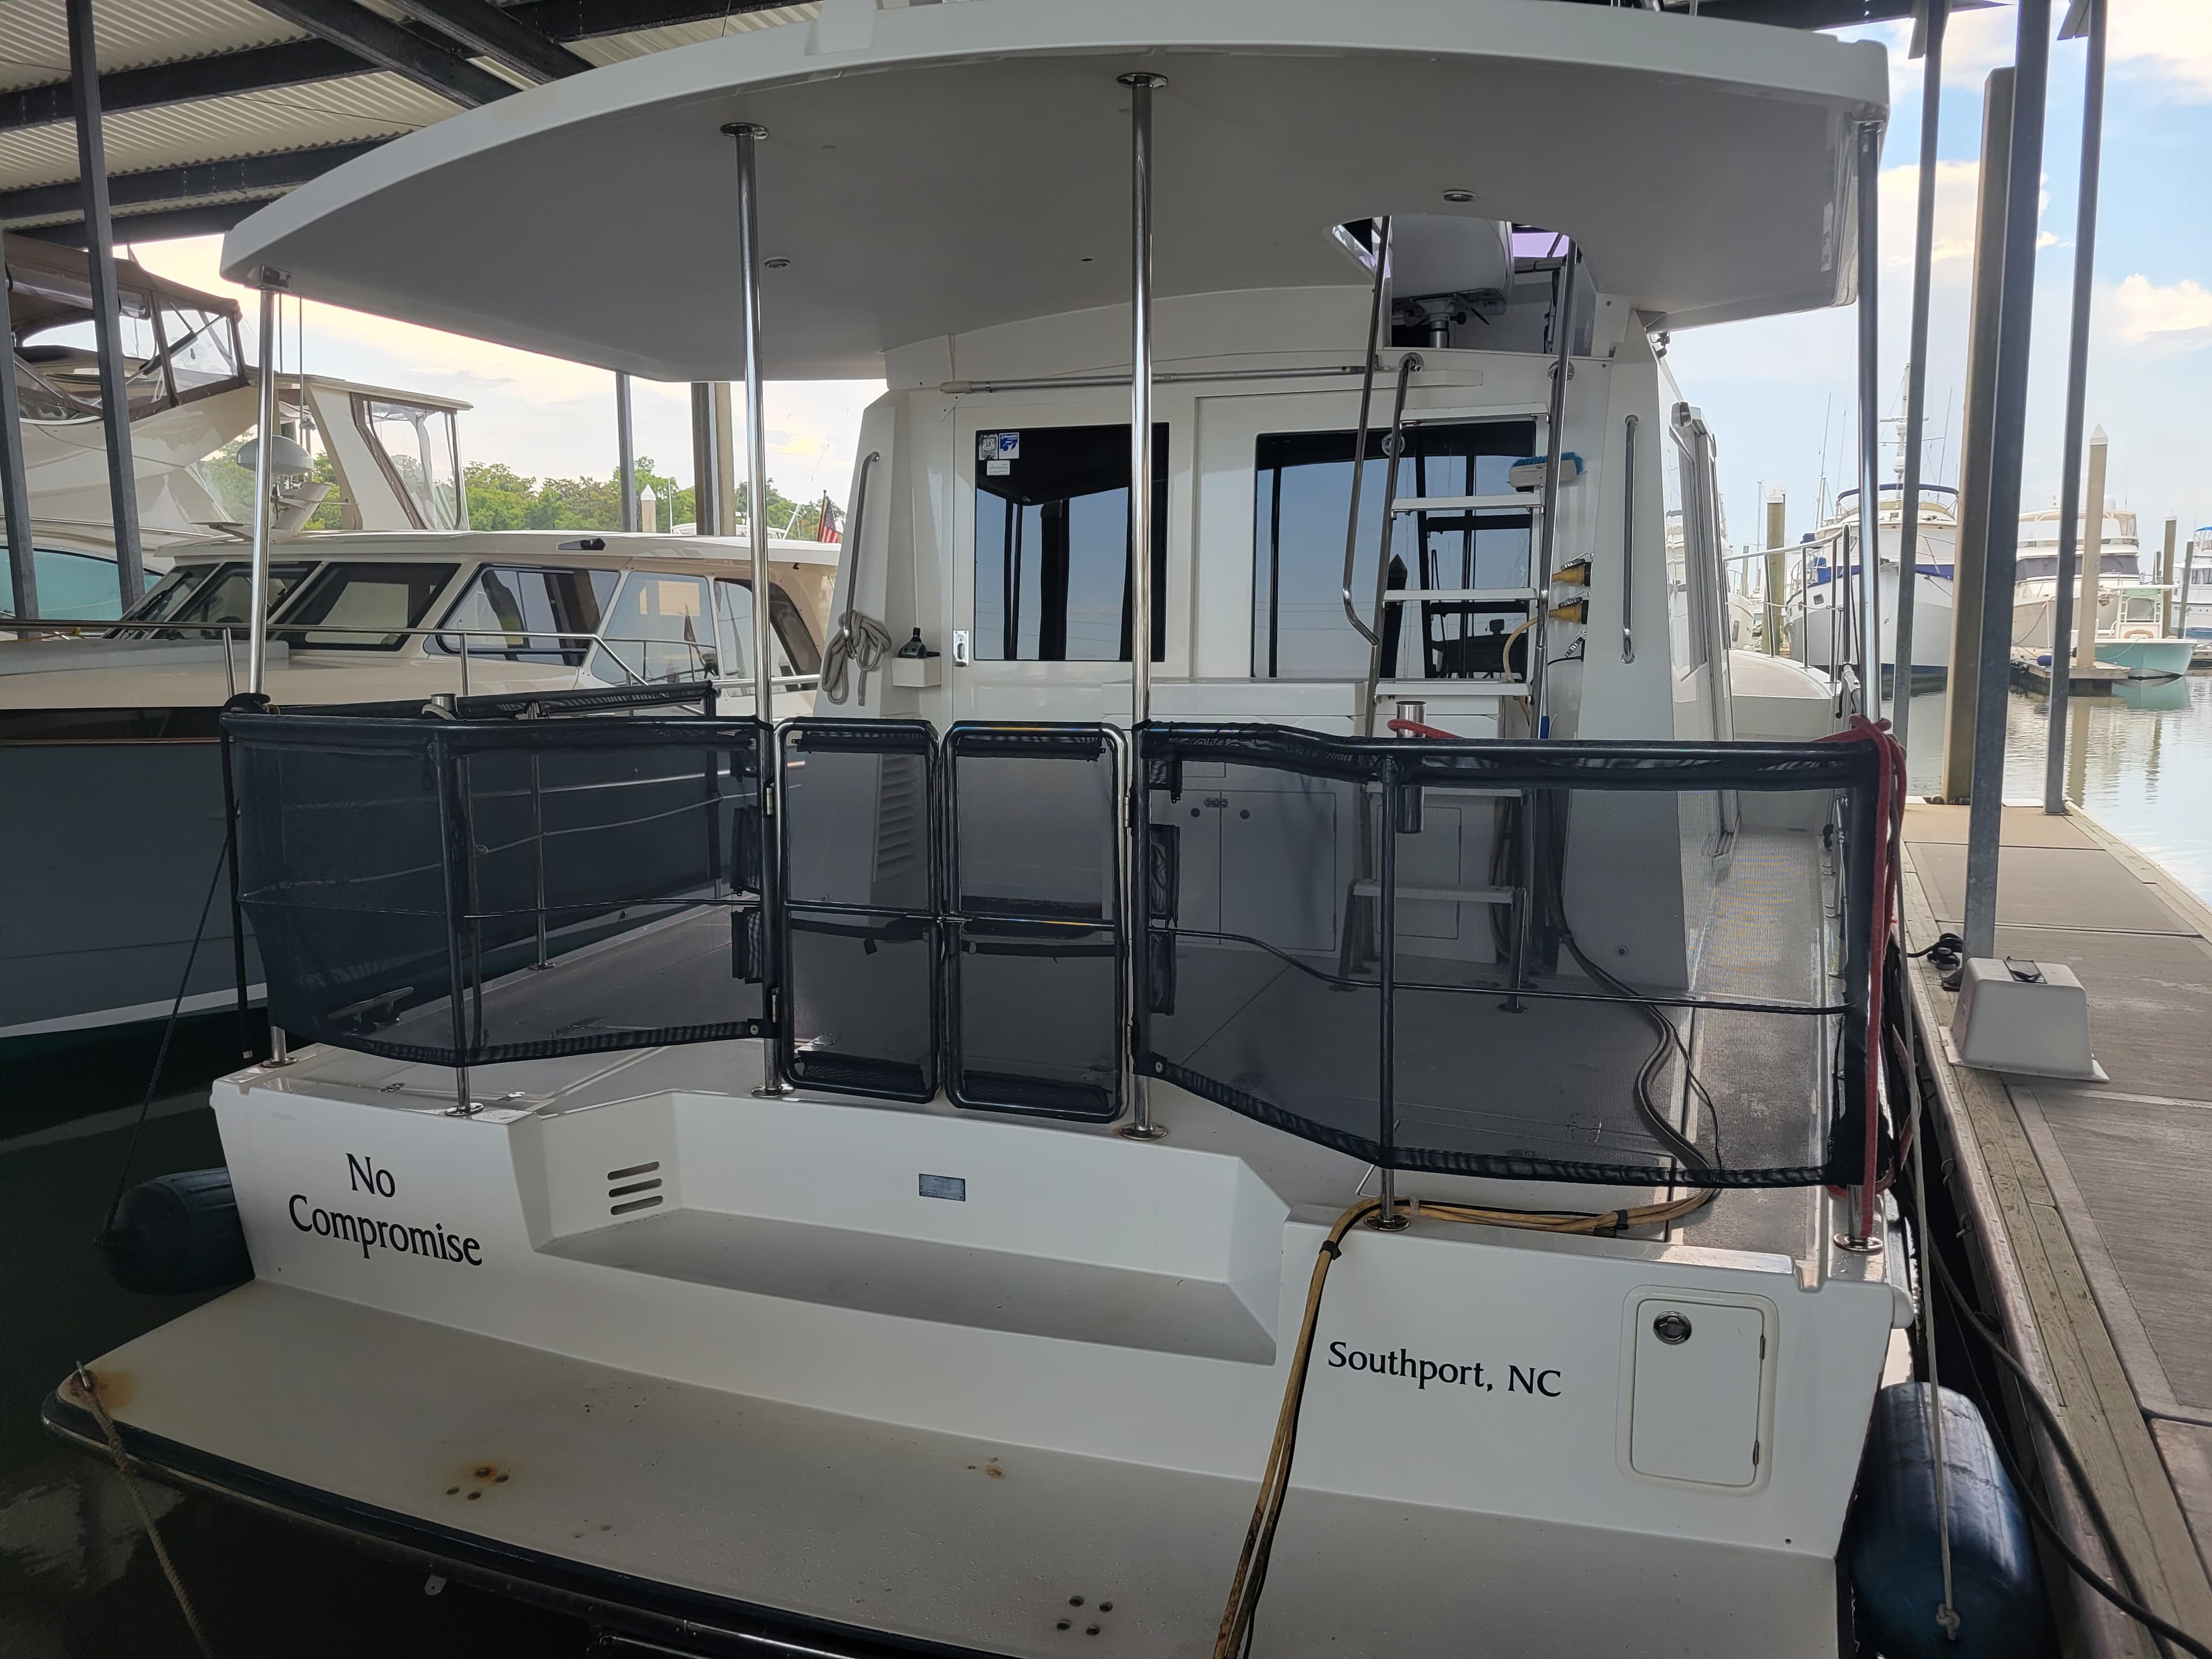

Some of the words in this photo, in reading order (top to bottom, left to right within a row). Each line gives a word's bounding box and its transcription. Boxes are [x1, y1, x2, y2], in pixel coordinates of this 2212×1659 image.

[346, 1152, 396, 1198] No
[289, 1194, 483, 1266] Compromise
[1328, 1341, 1494, 1392] Southport,
[1507, 1365, 1562, 1397] NC
